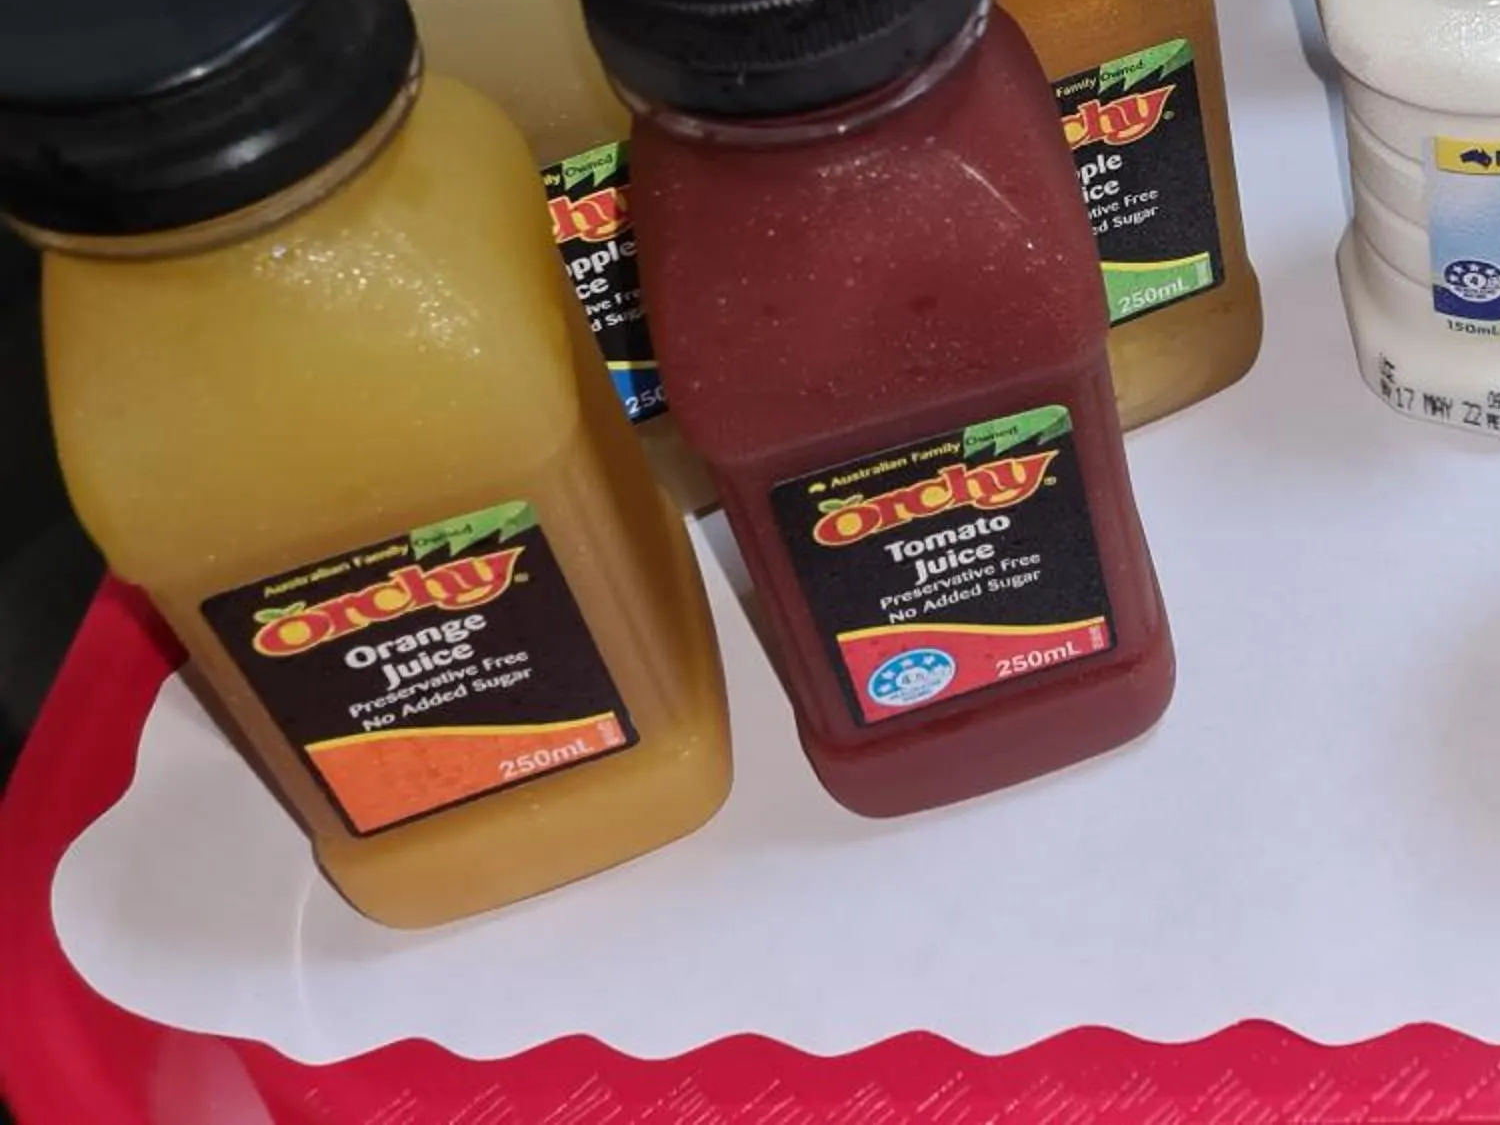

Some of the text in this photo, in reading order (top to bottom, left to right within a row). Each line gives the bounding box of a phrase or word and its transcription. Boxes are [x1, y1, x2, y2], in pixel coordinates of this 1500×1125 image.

[1056, 76, 1097, 98] Family
[1076, 154, 1123, 185] ple
[1081, 179, 1120, 204] ice
[1123, 189, 1159, 208] Free
[1112, 206, 1159, 229] Sugar
[566, 240, 639, 281] pple
[575, 277, 610, 300] ce
[1447, 318, 1500, 337] 150mL
[1395, 386, 1415, 411] 17
[1422, 393, 1453, 422] MAY
[1461, 400, 1482, 427] 22
[830, 457, 908, 489] Australian
[911, 441, 962, 463] Family
[883, 514, 1011, 563] Tomato
[879, 553, 1041, 610] Preservative Free
[915, 543, 996, 586] Juice
[888, 569, 1042, 625] No Added Sugar
[344, 613, 488, 669] Orange
[995, 641, 1082, 678] 250mL
[348, 650, 530, 719] Preservative Free
[381, 642, 476, 692] Juice
[361, 667, 533, 732] No Added Sugar
[498, 738, 596, 780] 250mL
